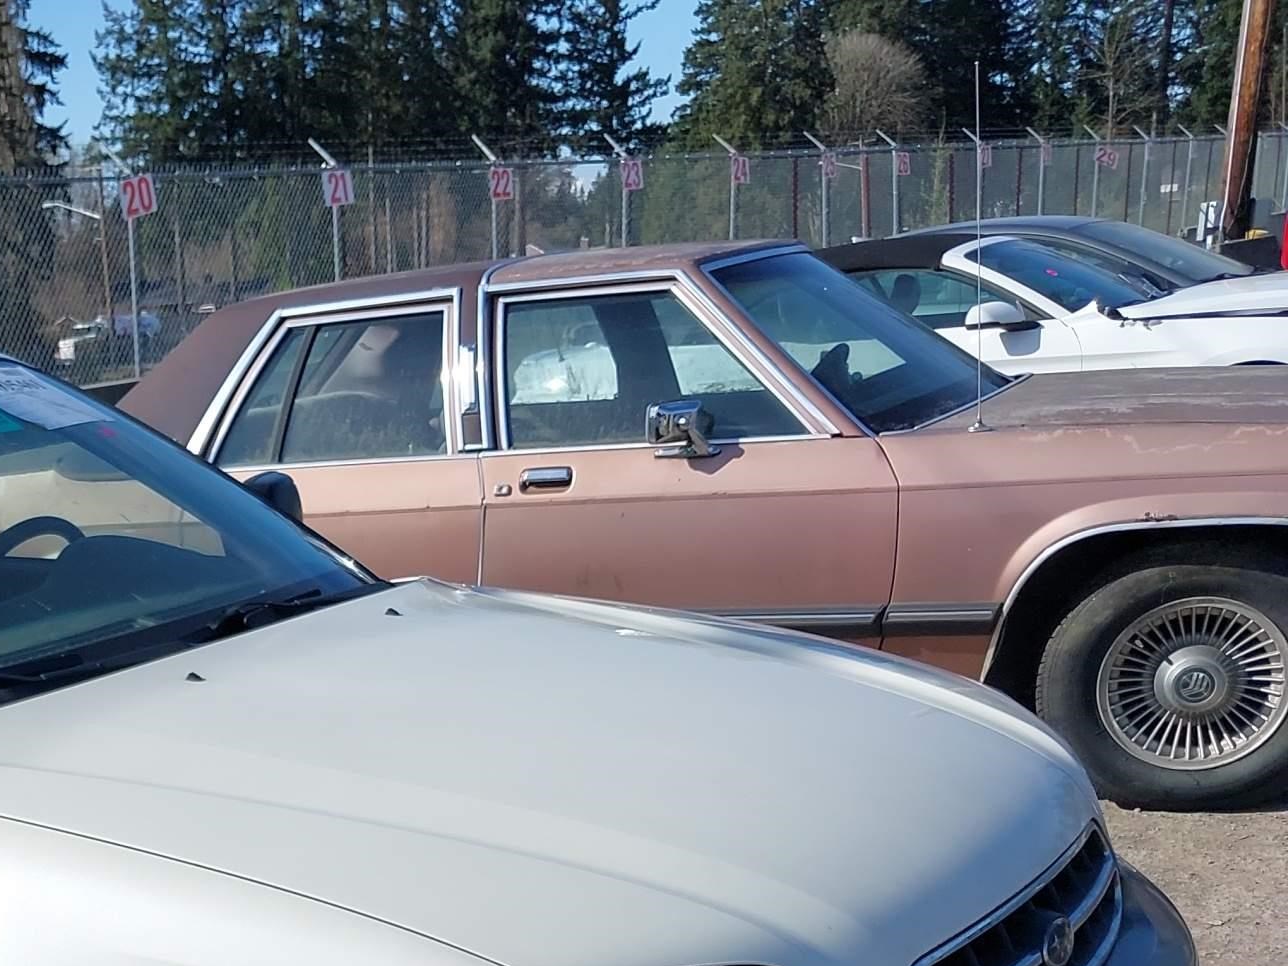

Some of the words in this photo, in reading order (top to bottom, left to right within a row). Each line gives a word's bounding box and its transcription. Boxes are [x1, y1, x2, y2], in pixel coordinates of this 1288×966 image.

[733, 157, 748, 182] 24
[1096, 146, 1116, 168] 29
[328, 172, 349, 203] 21
[492, 169, 511, 198] 22
[623, 161, 641, 188] 23
[123, 176, 152, 216] 20
